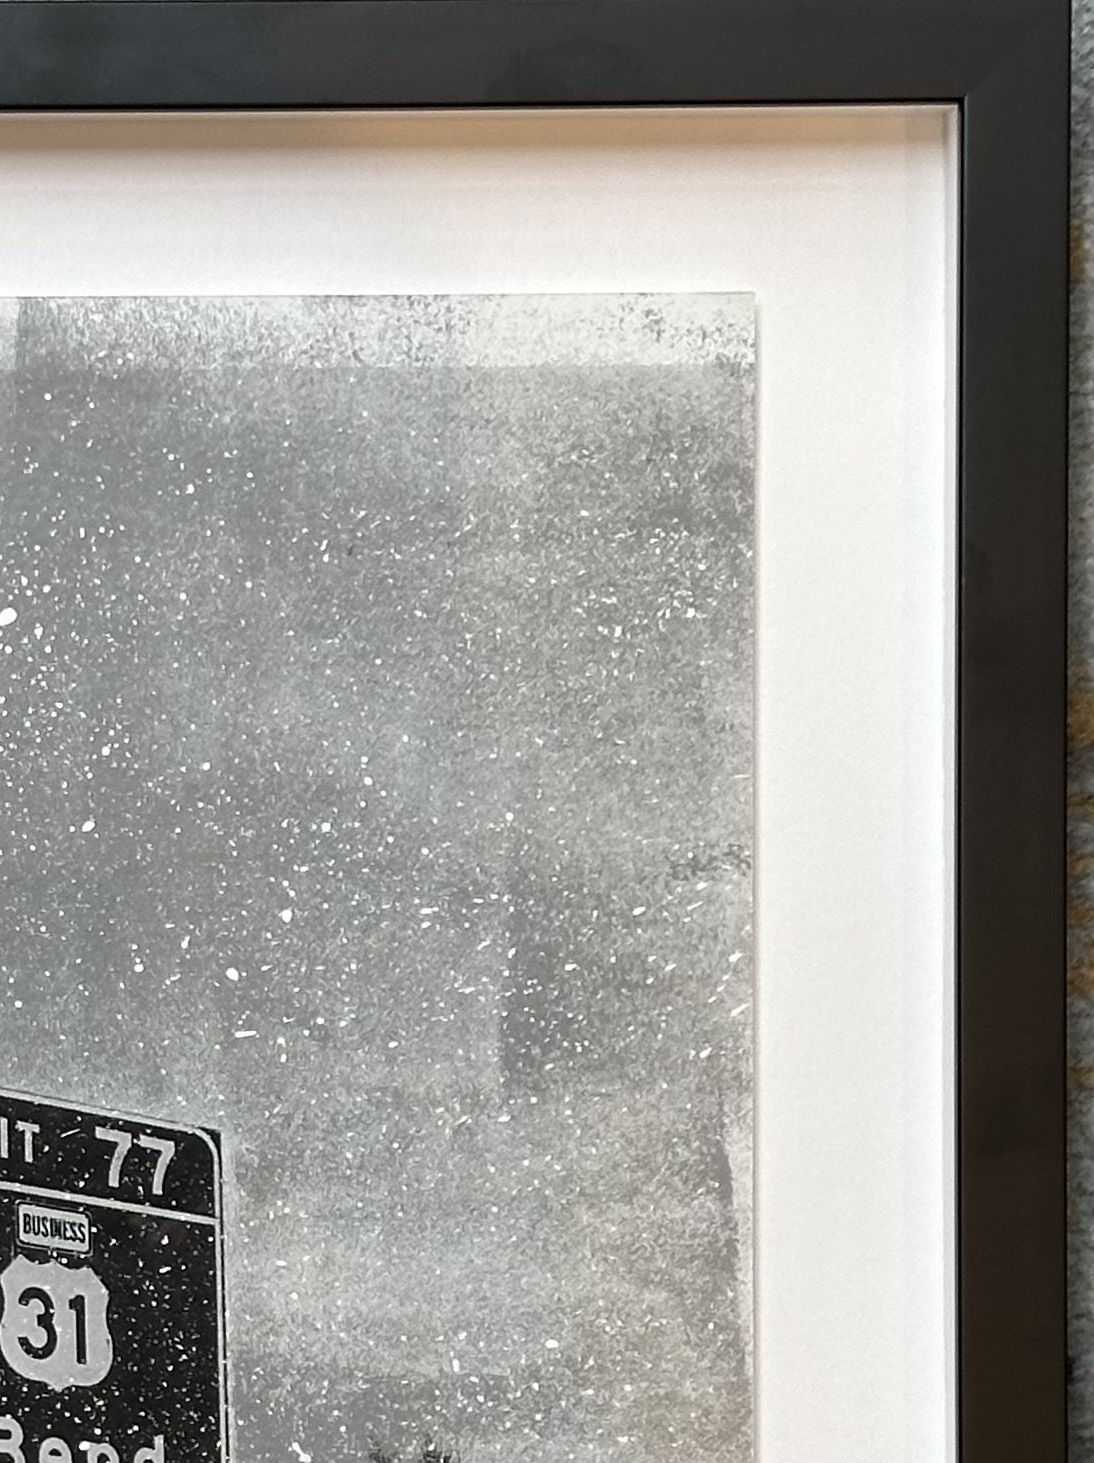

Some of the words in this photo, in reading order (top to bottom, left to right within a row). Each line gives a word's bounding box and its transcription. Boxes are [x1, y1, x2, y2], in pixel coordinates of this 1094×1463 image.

[94, 1127, 176, 1195] 77
[21, 1211, 88, 1246] BUSINESS
[17, 1286, 88, 1366] 31
